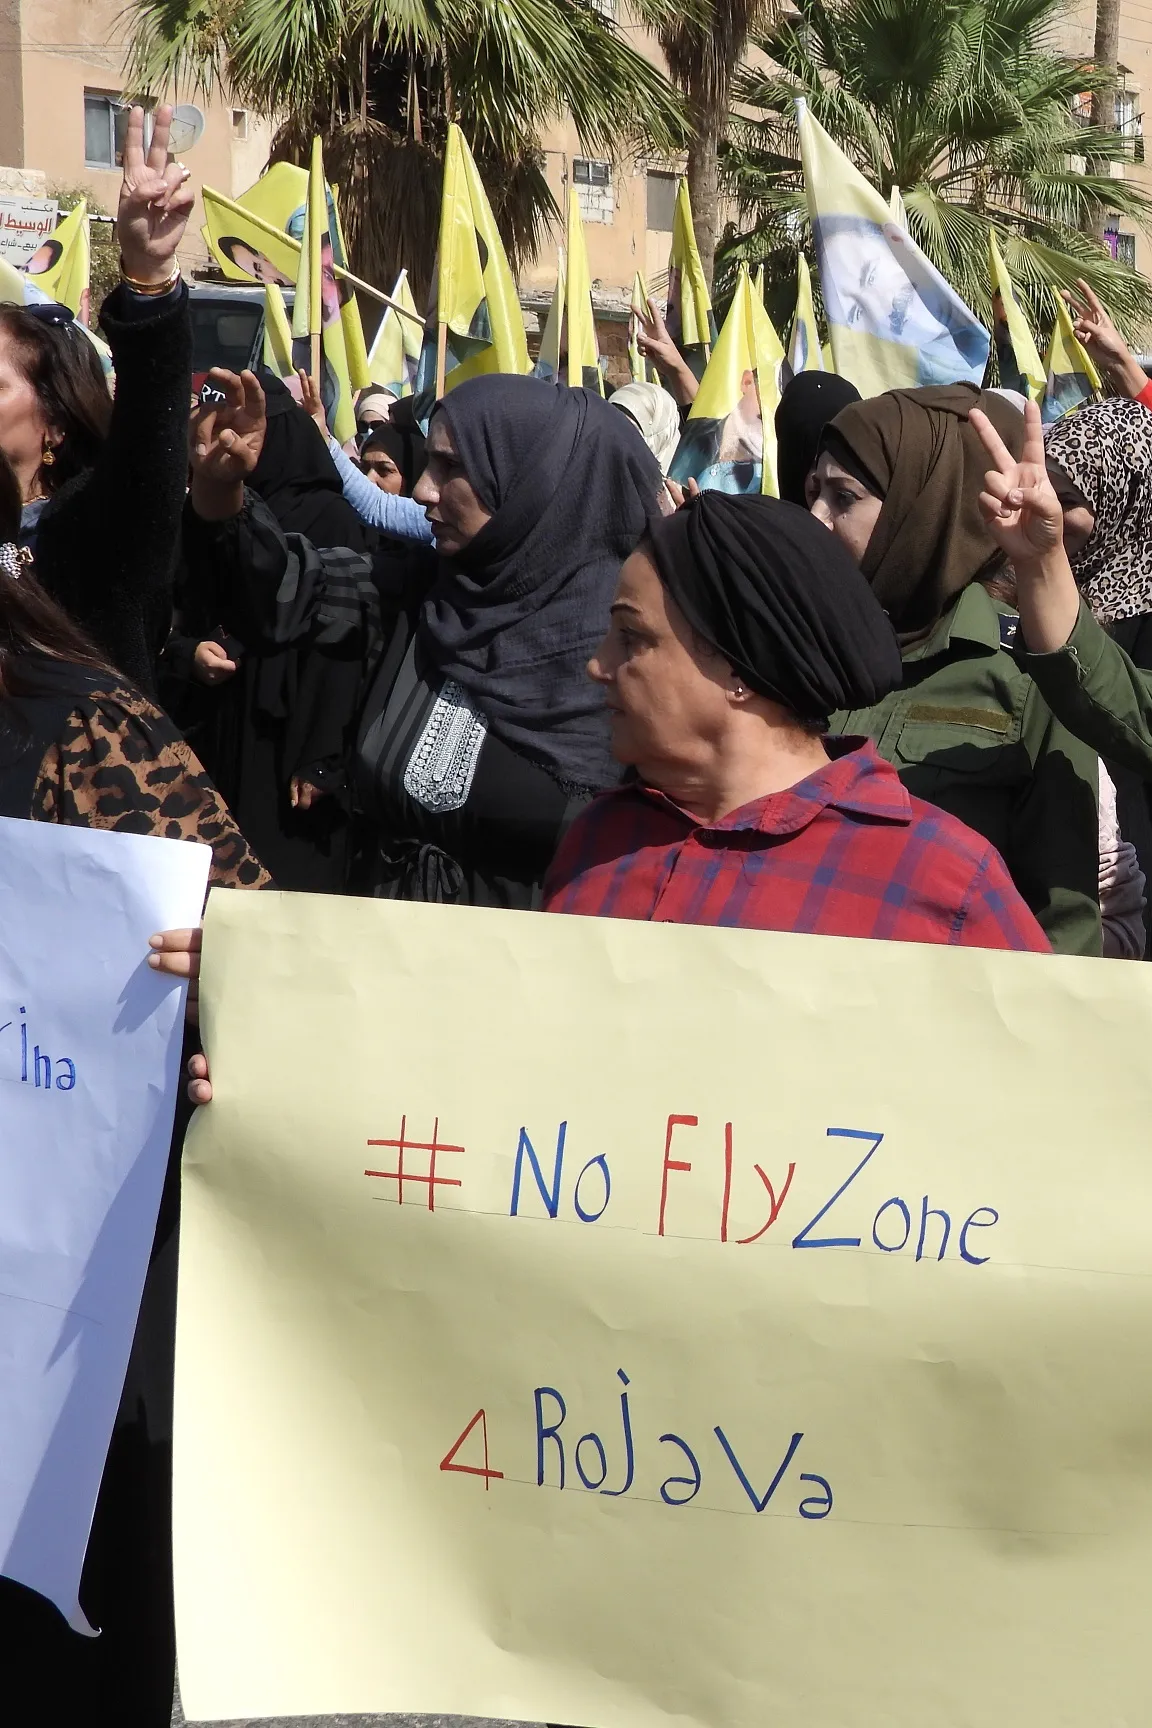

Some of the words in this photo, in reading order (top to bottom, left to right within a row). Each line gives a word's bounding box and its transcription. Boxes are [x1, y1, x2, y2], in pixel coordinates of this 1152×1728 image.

[510, 1120, 612, 1224] No
[658, 1113, 797, 1245] Fly
[792, 1127, 1000, 1266] Zone
[440, 1408, 504, 1491] 4
